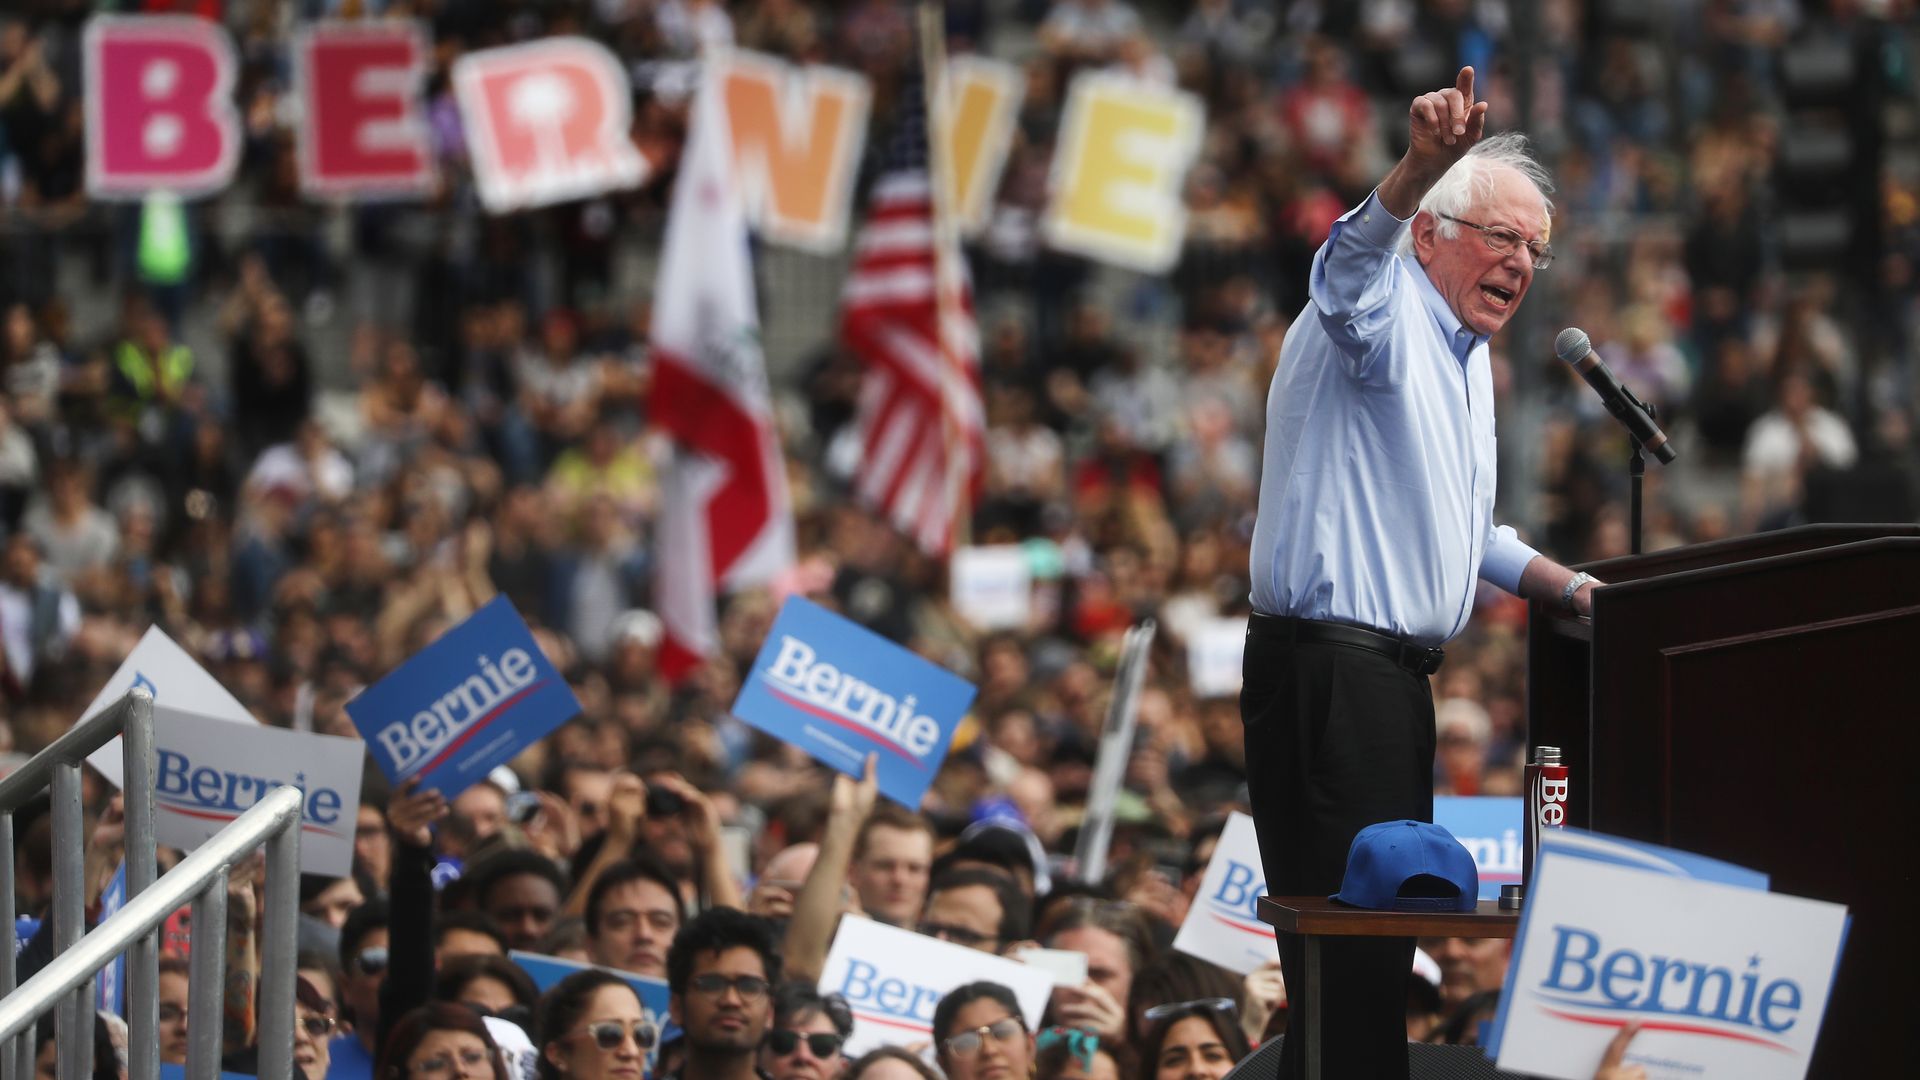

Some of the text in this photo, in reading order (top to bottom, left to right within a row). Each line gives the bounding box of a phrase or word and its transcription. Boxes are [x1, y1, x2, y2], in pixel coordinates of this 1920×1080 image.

[376, 647, 537, 771] Bernie
[767, 634, 940, 757] Bernie
[1541, 776, 1569, 826] Be
[1540, 924, 1803, 1033] Bernie
